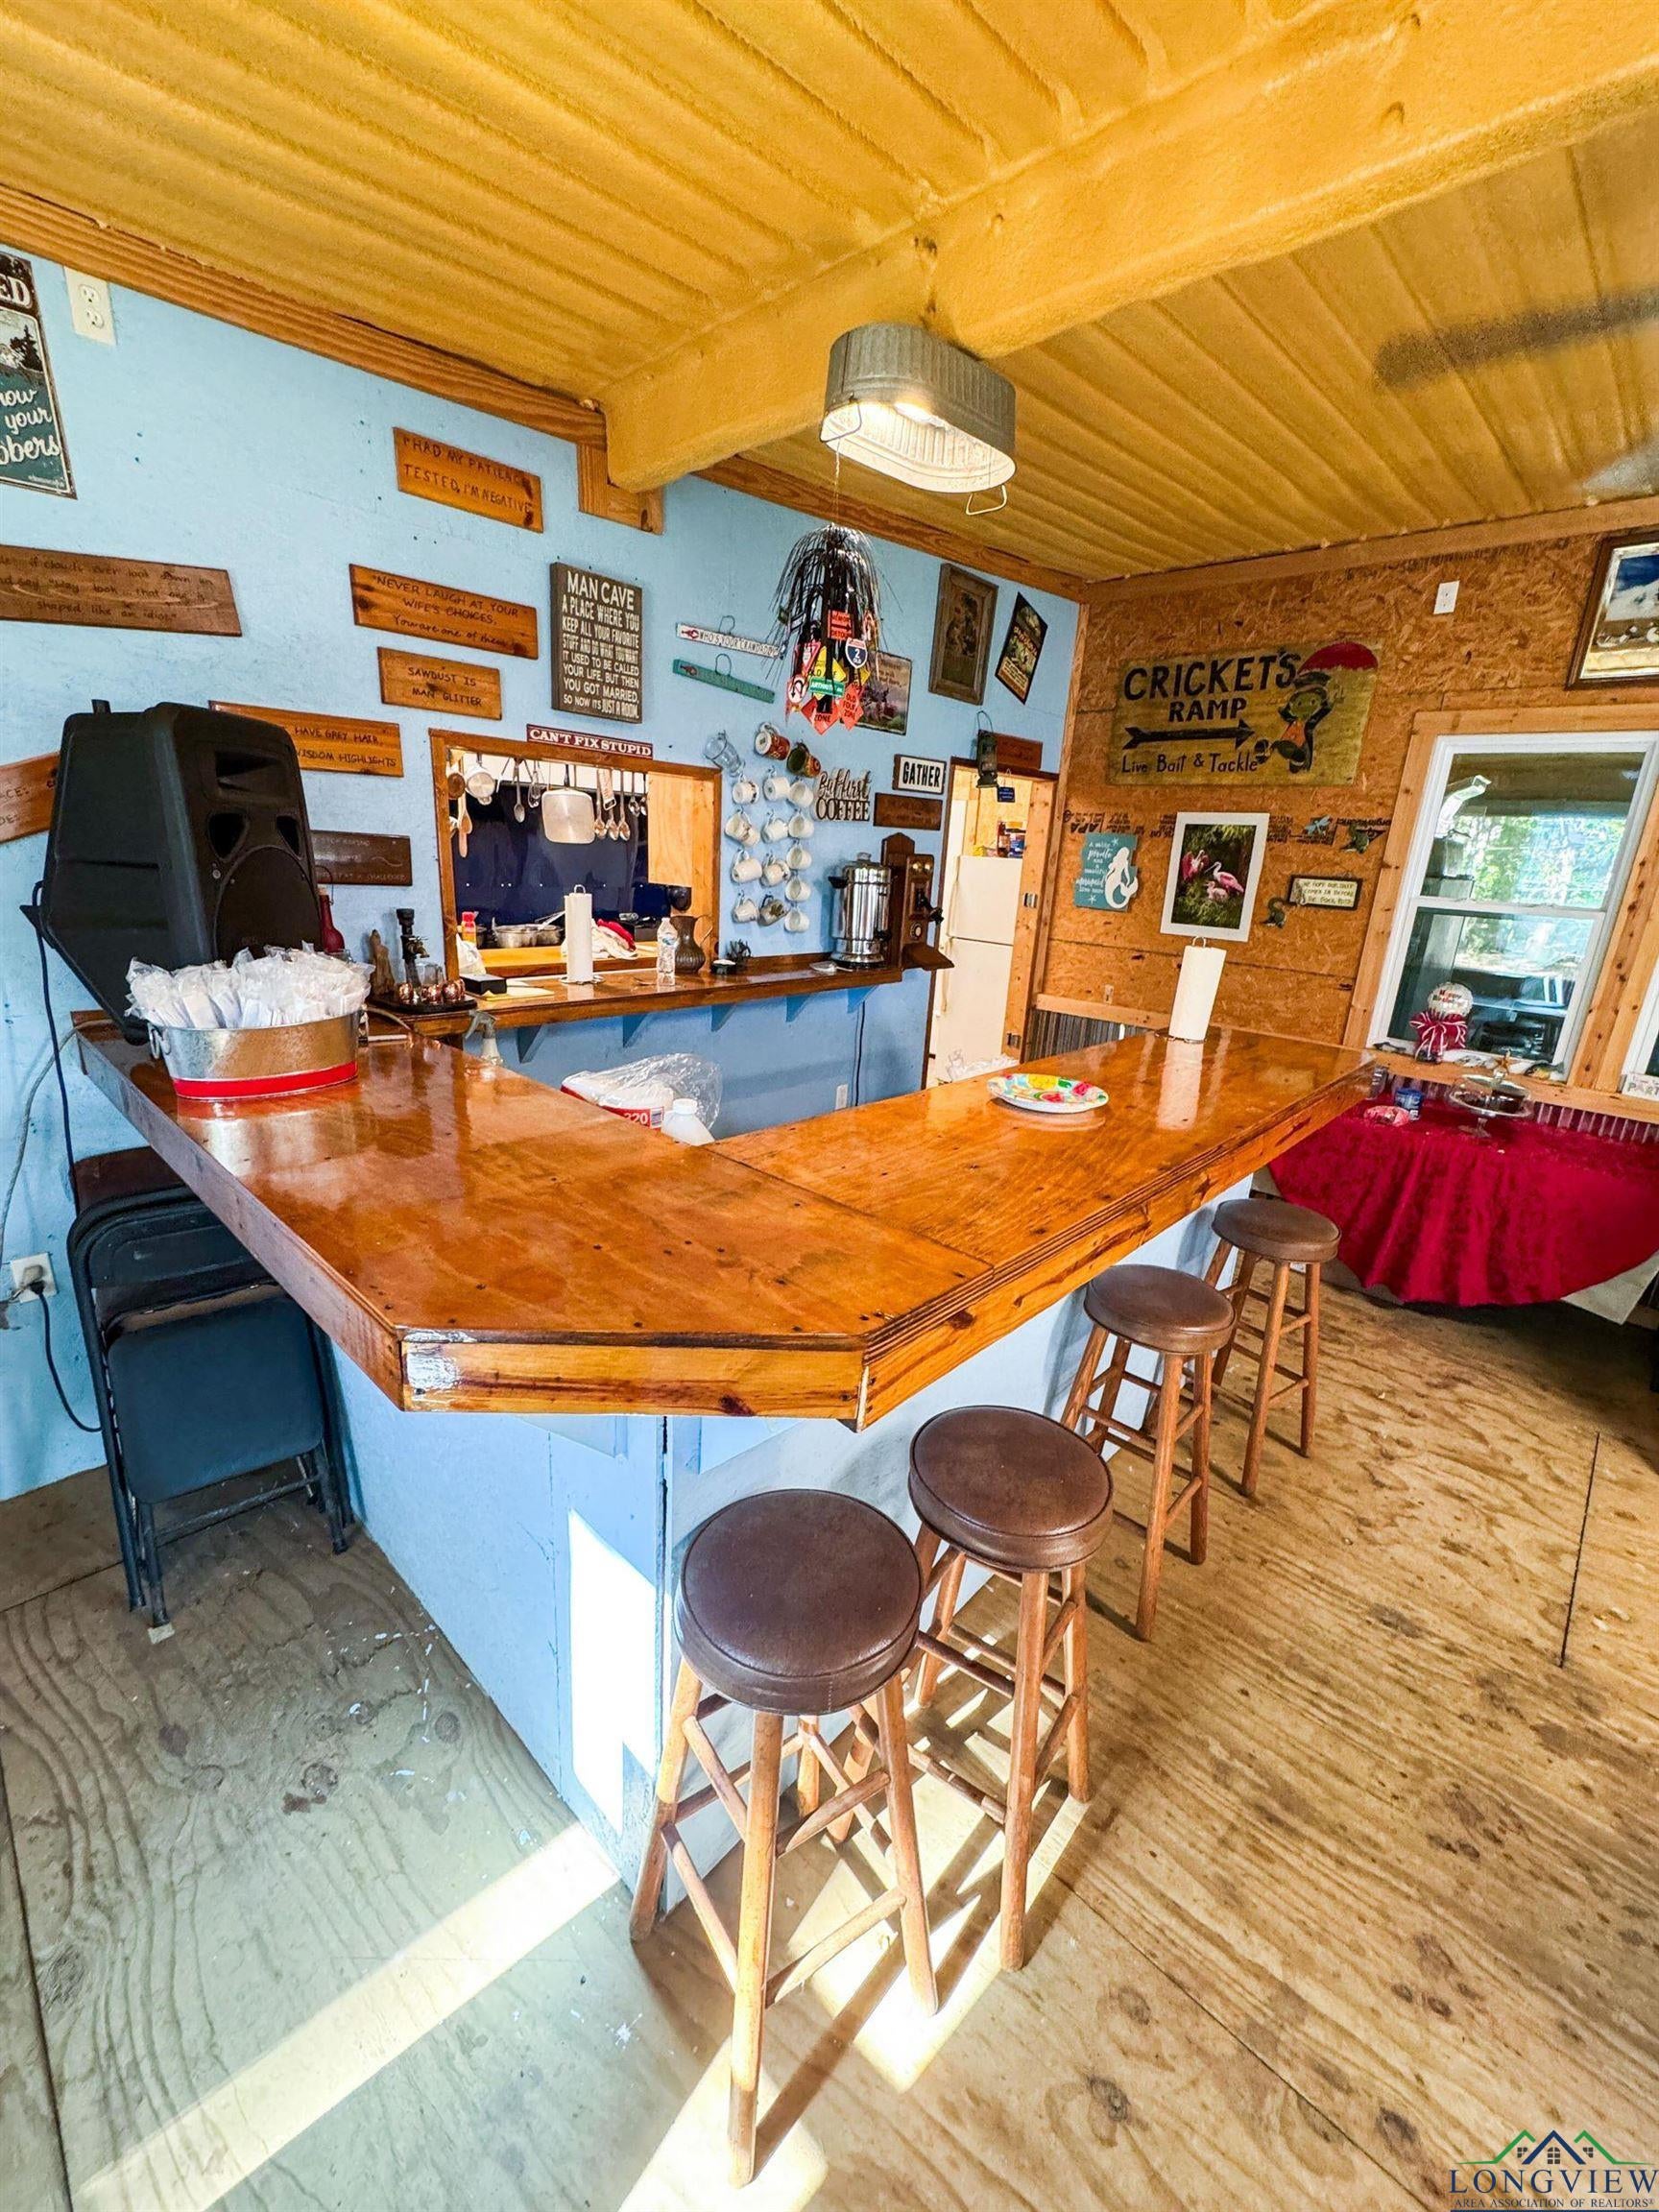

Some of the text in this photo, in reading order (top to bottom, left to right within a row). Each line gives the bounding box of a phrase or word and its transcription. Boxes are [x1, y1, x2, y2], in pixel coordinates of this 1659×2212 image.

[5, 407, 52, 434] your
[413, 438, 442, 458] HAD
[482, 488, 534, 515] NEGATIVE
[375, 576, 519, 618] NEVER LAUGH AT YOUR
[567, 569, 636, 611] MAN CAVE
[562, 593, 640, 633] A PLACE WHERE YOU
[562, 615, 640, 649] KEEP ALL YOUR FAVORITE
[562, 633, 579, 651] STUFF
[580, 637, 591, 654] AND
[563, 650, 640, 677] IT USED TO BE CALLED
[563, 662, 585, 678] YOUR
[605, 672, 619, 685] BUT
[620, 675, 639, 689] THEN
[407, 666, 477, 688] SAWDUST IS
[564, 676, 581, 692] YOU
[583, 681, 601, 696] GOT
[412, 686, 482, 708] MAN GLITTER
[564, 693, 573, 705] SO
[574, 695, 591, 708] NOW
[601, 698, 615, 714] JUST
[1168, 698, 1247, 722] RAMP
[295, 726, 323, 738] HAVE
[325, 730, 349, 741] GREY
[529, 729, 652, 757] CAN'T FIX STUPID
[339, 752, 397, 767] HIGHLIGHTS
[1121, 753, 1259, 774] Live Bait & Tackle
[902, 761, 941, 787] GATHER
[816, 798, 871, 821] COFFEE
